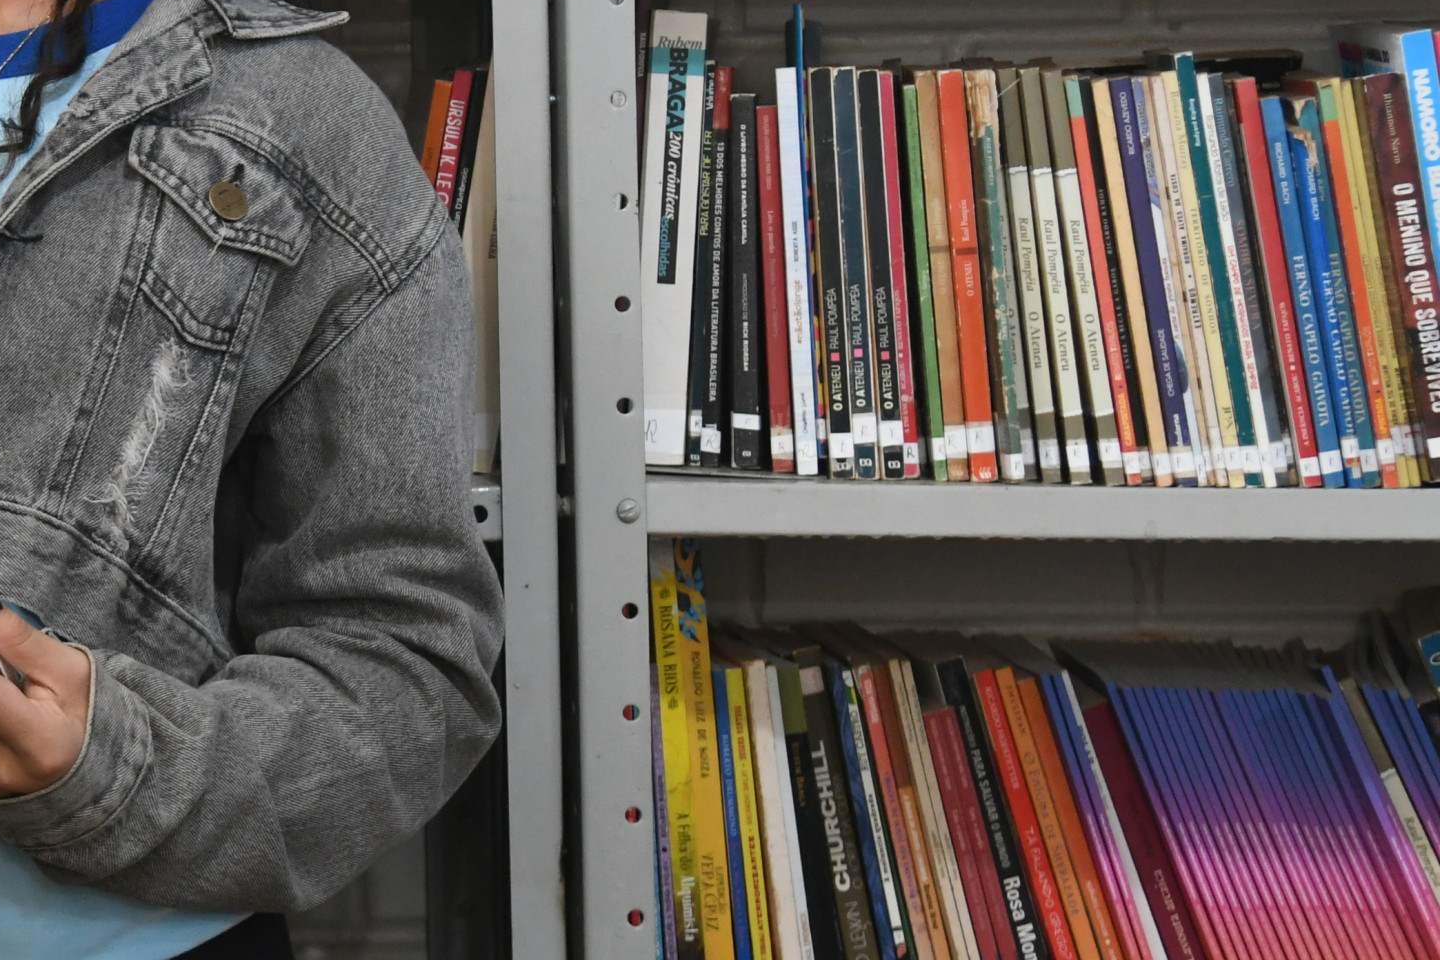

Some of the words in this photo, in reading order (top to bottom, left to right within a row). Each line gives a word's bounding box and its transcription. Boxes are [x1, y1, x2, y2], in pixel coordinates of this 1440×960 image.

[666, 48, 687, 131] BRAGA
[1119, 91, 1130, 123] AZEVEDO
[442, 98, 468, 151] URSULA
[1213, 96, 1230, 146] Raimundo
[1410, 67, 1440, 161] NAMORO
[667, 131, 684, 158] 200
[1123, 124, 1134, 154] RICARDO
[660, 160, 684, 220] crônicas
[714, 170, 723, 214] MELHORES
[1273, 141, 1287, 178] RICHARD
[1280, 180, 1292, 205] BACH
[656, 217, 674, 276] escolhidas
[713, 216, 721, 248] CONTOS
[1018, 216, 1030, 242] Raul
[1042, 217, 1056, 244] Raul
[1070, 219, 1083, 245] Raul
[1394, 198, 1426, 266] MENINO
[712, 250, 720, 260] DE
[712, 263, 720, 286] AMOR
[711, 288, 719, 299] DA
[1292, 254, 1313, 306] FERNÃO
[709, 301, 719, 351] LITERATURA
[1028, 310, 1038, 320] O
[1054, 313, 1065, 324] O
[1084, 313, 1094, 323] O
[1029, 324, 1043, 369] Ateneu
[1056, 327, 1071, 372] Ateneu
[1085, 326, 1100, 371] Ateneu
[1155, 327, 1169, 360] SAUDADE
[1301, 312, 1319, 364] CAPELO
[708, 353, 717, 401] BRASILEIRA
[1163, 371, 1175, 397] CHEGA
[1337, 310, 1356, 362] CAPELO
[1347, 368, 1367, 423] GAIVOTA
[1310, 370, 1330, 426] GAIVOTA
[658, 604, 676, 658] ROSANA
[663, 664, 679, 694] RIOS
[690, 651, 703, 696] RONALDO
[720, 734, 731, 775] ROBERTO
[724, 778, 737, 836] DRUMMOND
[809, 739, 851, 893] CHURCHILL
[970, 748, 986, 778] PARA
[978, 779, 998, 822] SALVAR
[992, 831, 1011, 868] MUNDO
[674, 874, 704, 942] Alquimista
[1002, 875, 1029, 921] Rosa
